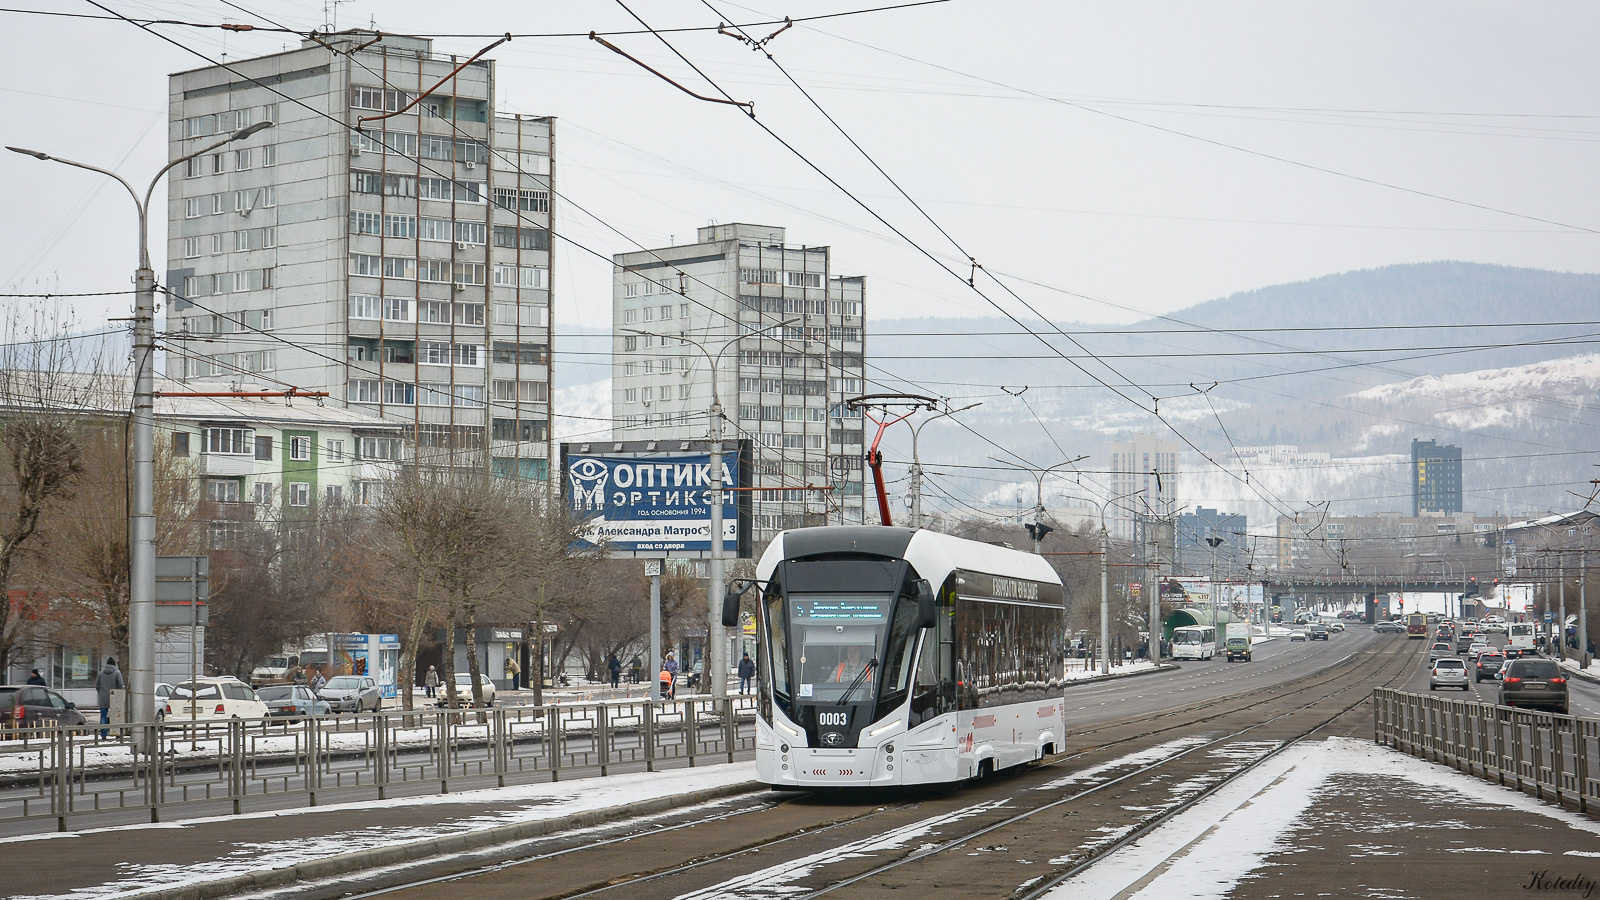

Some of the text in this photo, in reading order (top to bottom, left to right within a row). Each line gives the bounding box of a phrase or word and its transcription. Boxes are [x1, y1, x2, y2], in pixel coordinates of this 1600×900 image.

[613, 462, 734, 488] ОПТИКА
[651, 508, 689, 516] основания
[691, 507, 706, 515] 1994
[598, 526, 661, 537] Александра
[729, 525, 736, 534] 3
[819, 712, 847, 726] 0003
